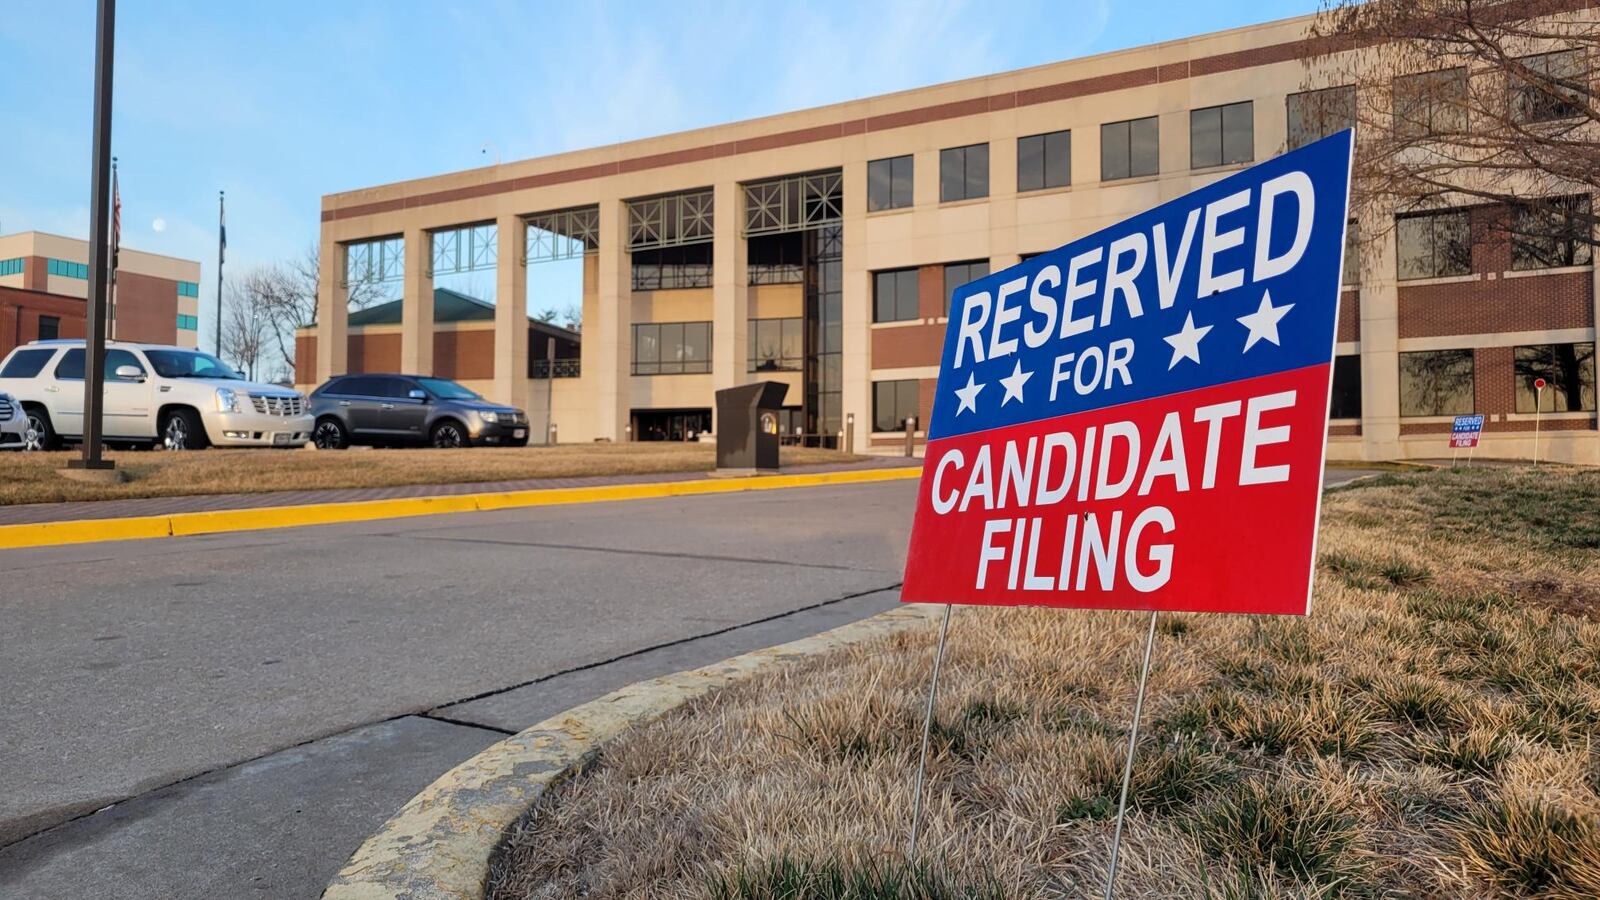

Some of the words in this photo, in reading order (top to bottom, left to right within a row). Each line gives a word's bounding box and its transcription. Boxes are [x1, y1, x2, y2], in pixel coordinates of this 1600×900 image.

[953, 171, 1315, 368] RESERVED
[1049, 338, 1135, 401] FOR
[931, 390, 1297, 515] CANDIDATE
[1451, 431, 1479, 440] CANDIDATE
[1454, 416, 1482, 426] RESERVED
[976, 506, 1176, 592] FILING
